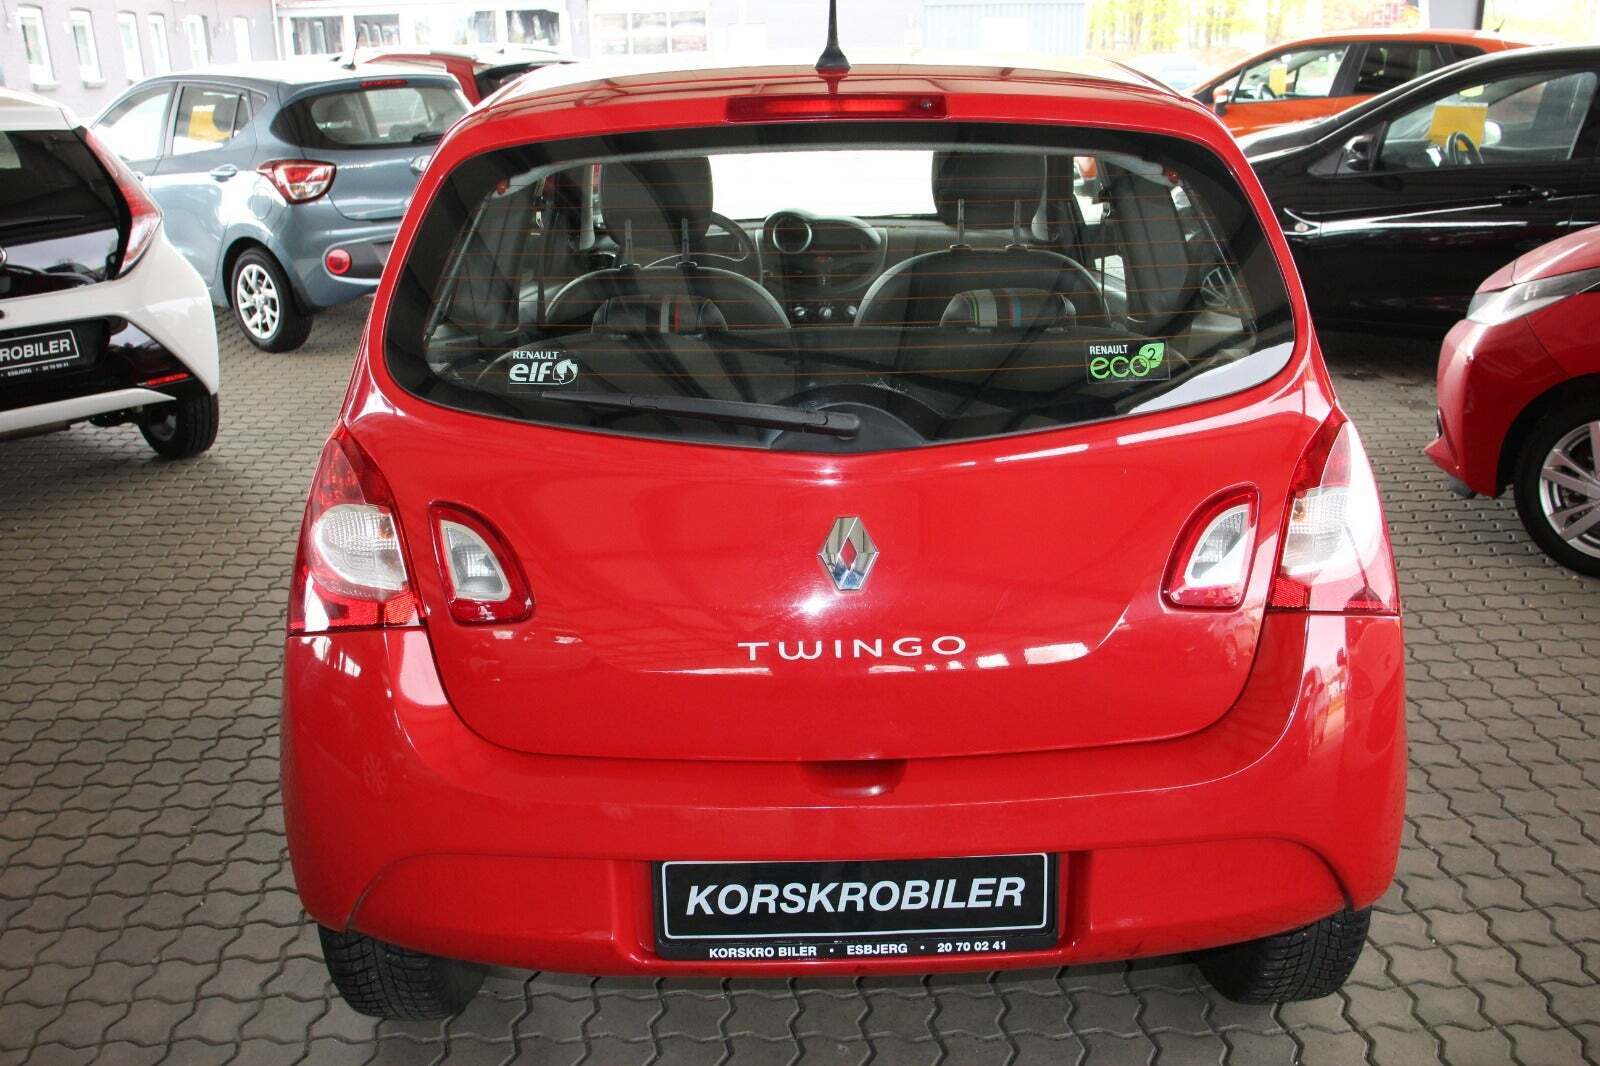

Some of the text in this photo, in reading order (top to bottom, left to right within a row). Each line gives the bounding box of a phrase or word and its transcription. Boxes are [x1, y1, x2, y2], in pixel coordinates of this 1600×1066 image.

[513, 351, 559, 359] RENAULT
[1089, 345, 1128, 355] RENAULT
[509, 361, 553, 382] elf
[737, 635, 967, 661] TWINGO
[685, 876, 1026, 916] KORSKROBILER
[708, 940, 1007, 959] KORSKRO BILER ESBJERG 20 70 02 41
